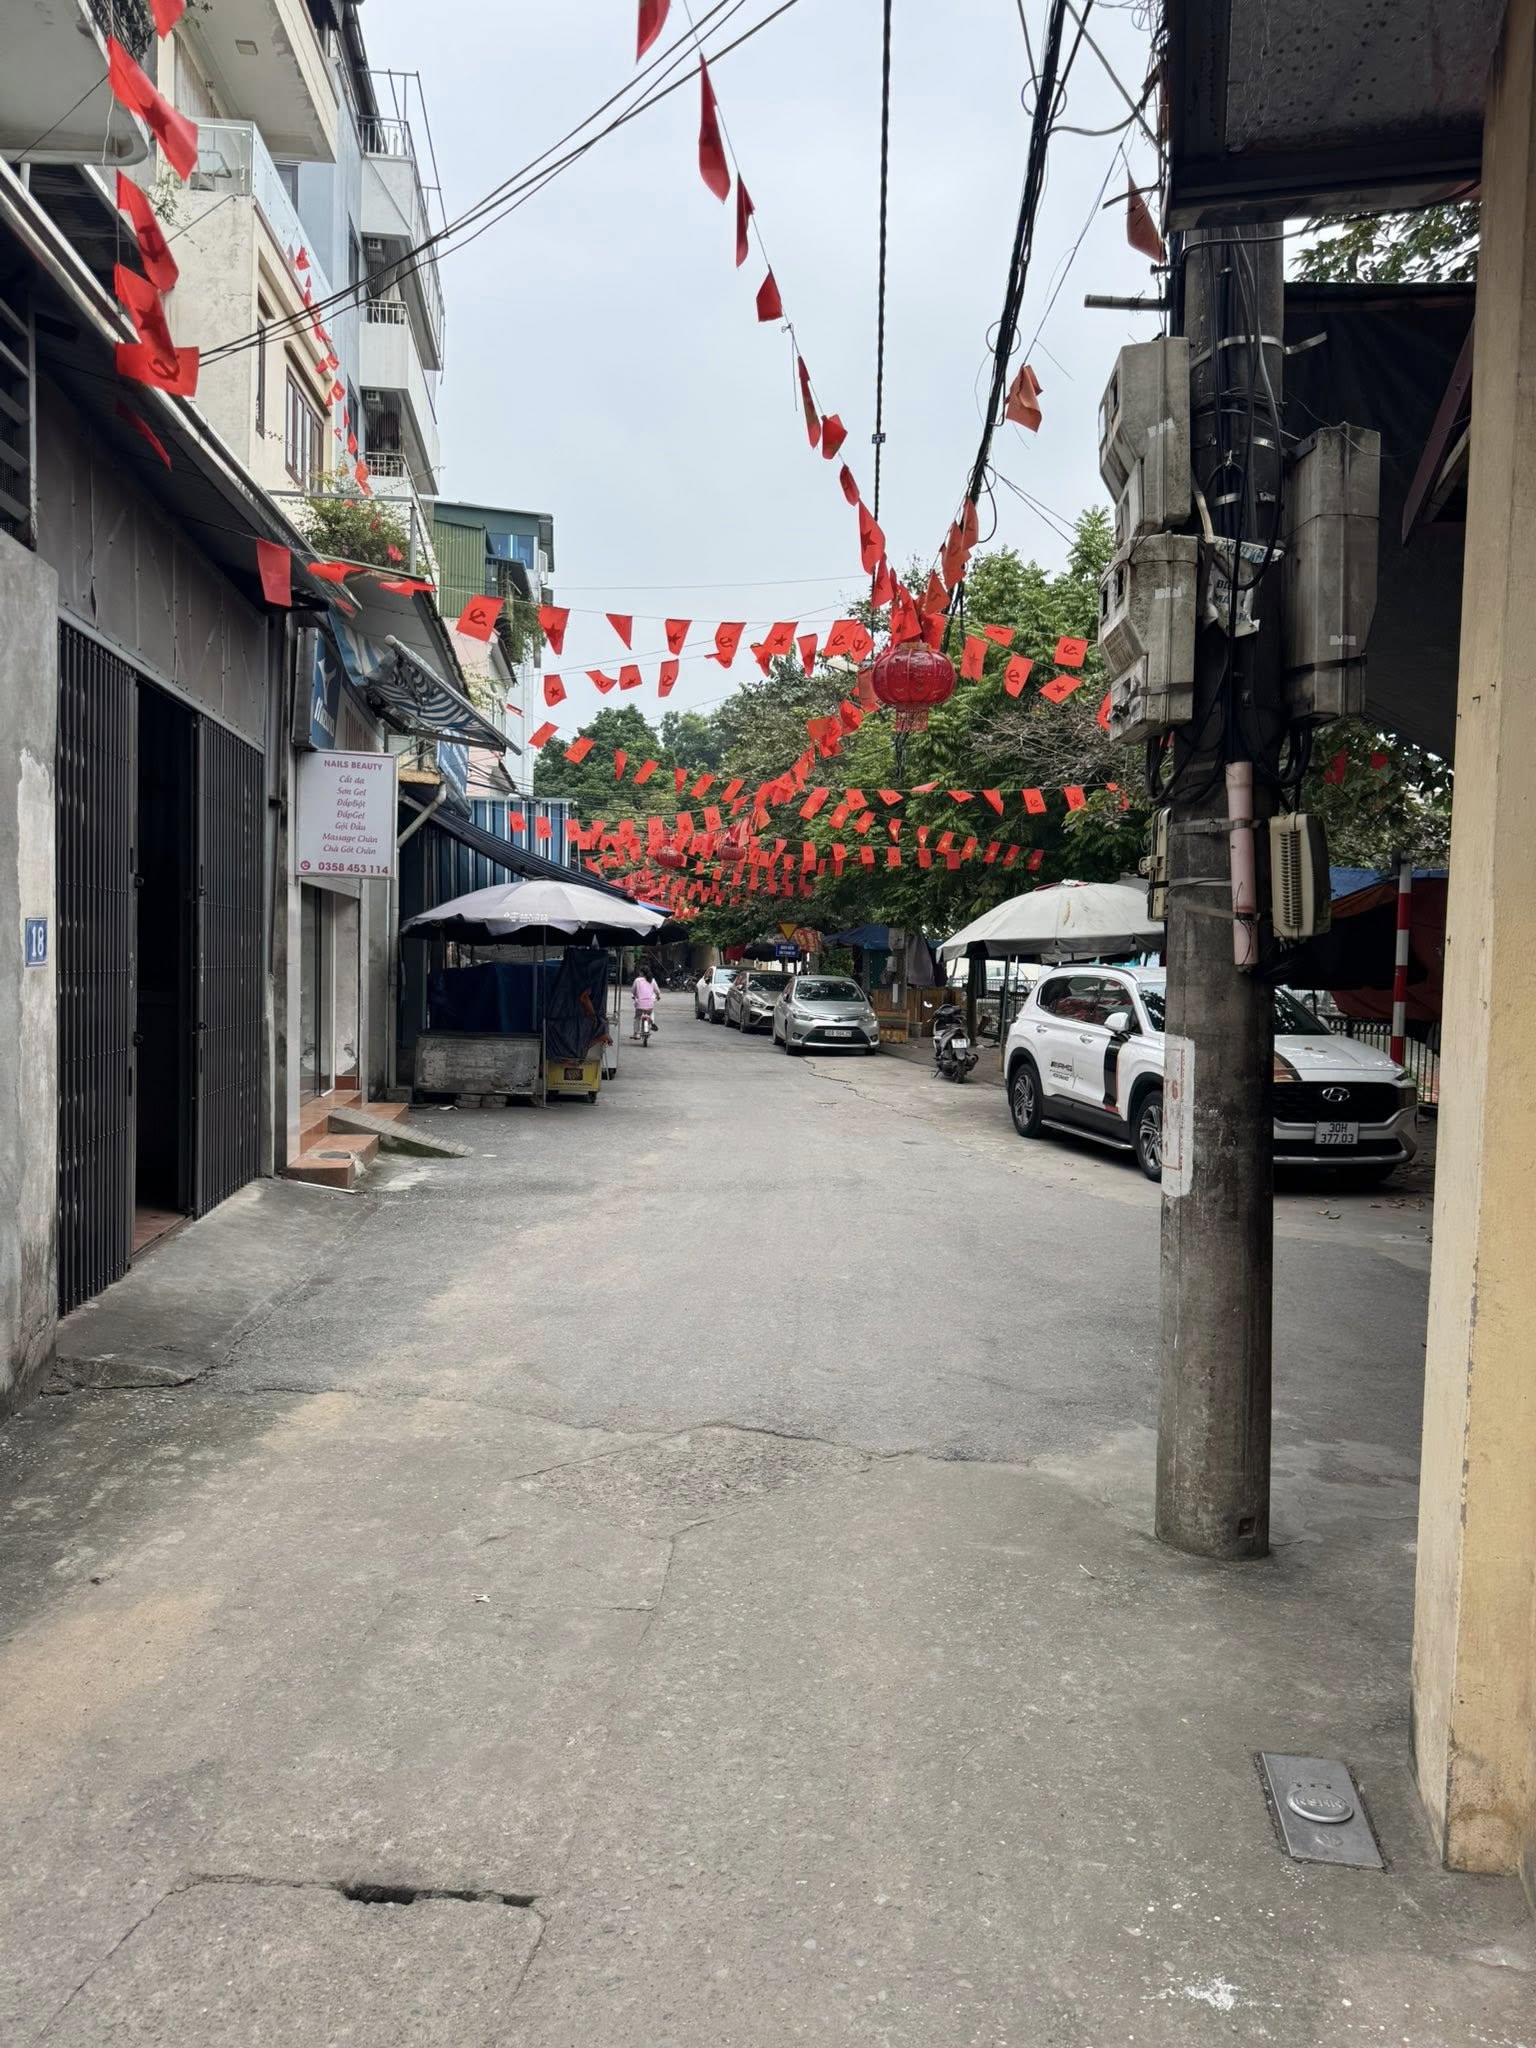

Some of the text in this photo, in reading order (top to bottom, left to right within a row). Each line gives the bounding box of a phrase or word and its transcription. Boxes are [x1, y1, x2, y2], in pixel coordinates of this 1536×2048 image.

[324, 760, 383, 770] NAILS BEAUTY
[354, 776, 365, 784] da
[322, 833, 356, 842] Massage
[318, 862, 389, 874] 0358 453 114
[31, 926, 44, 957] 18
[1329, 1122, 1347, 1132] 30H
